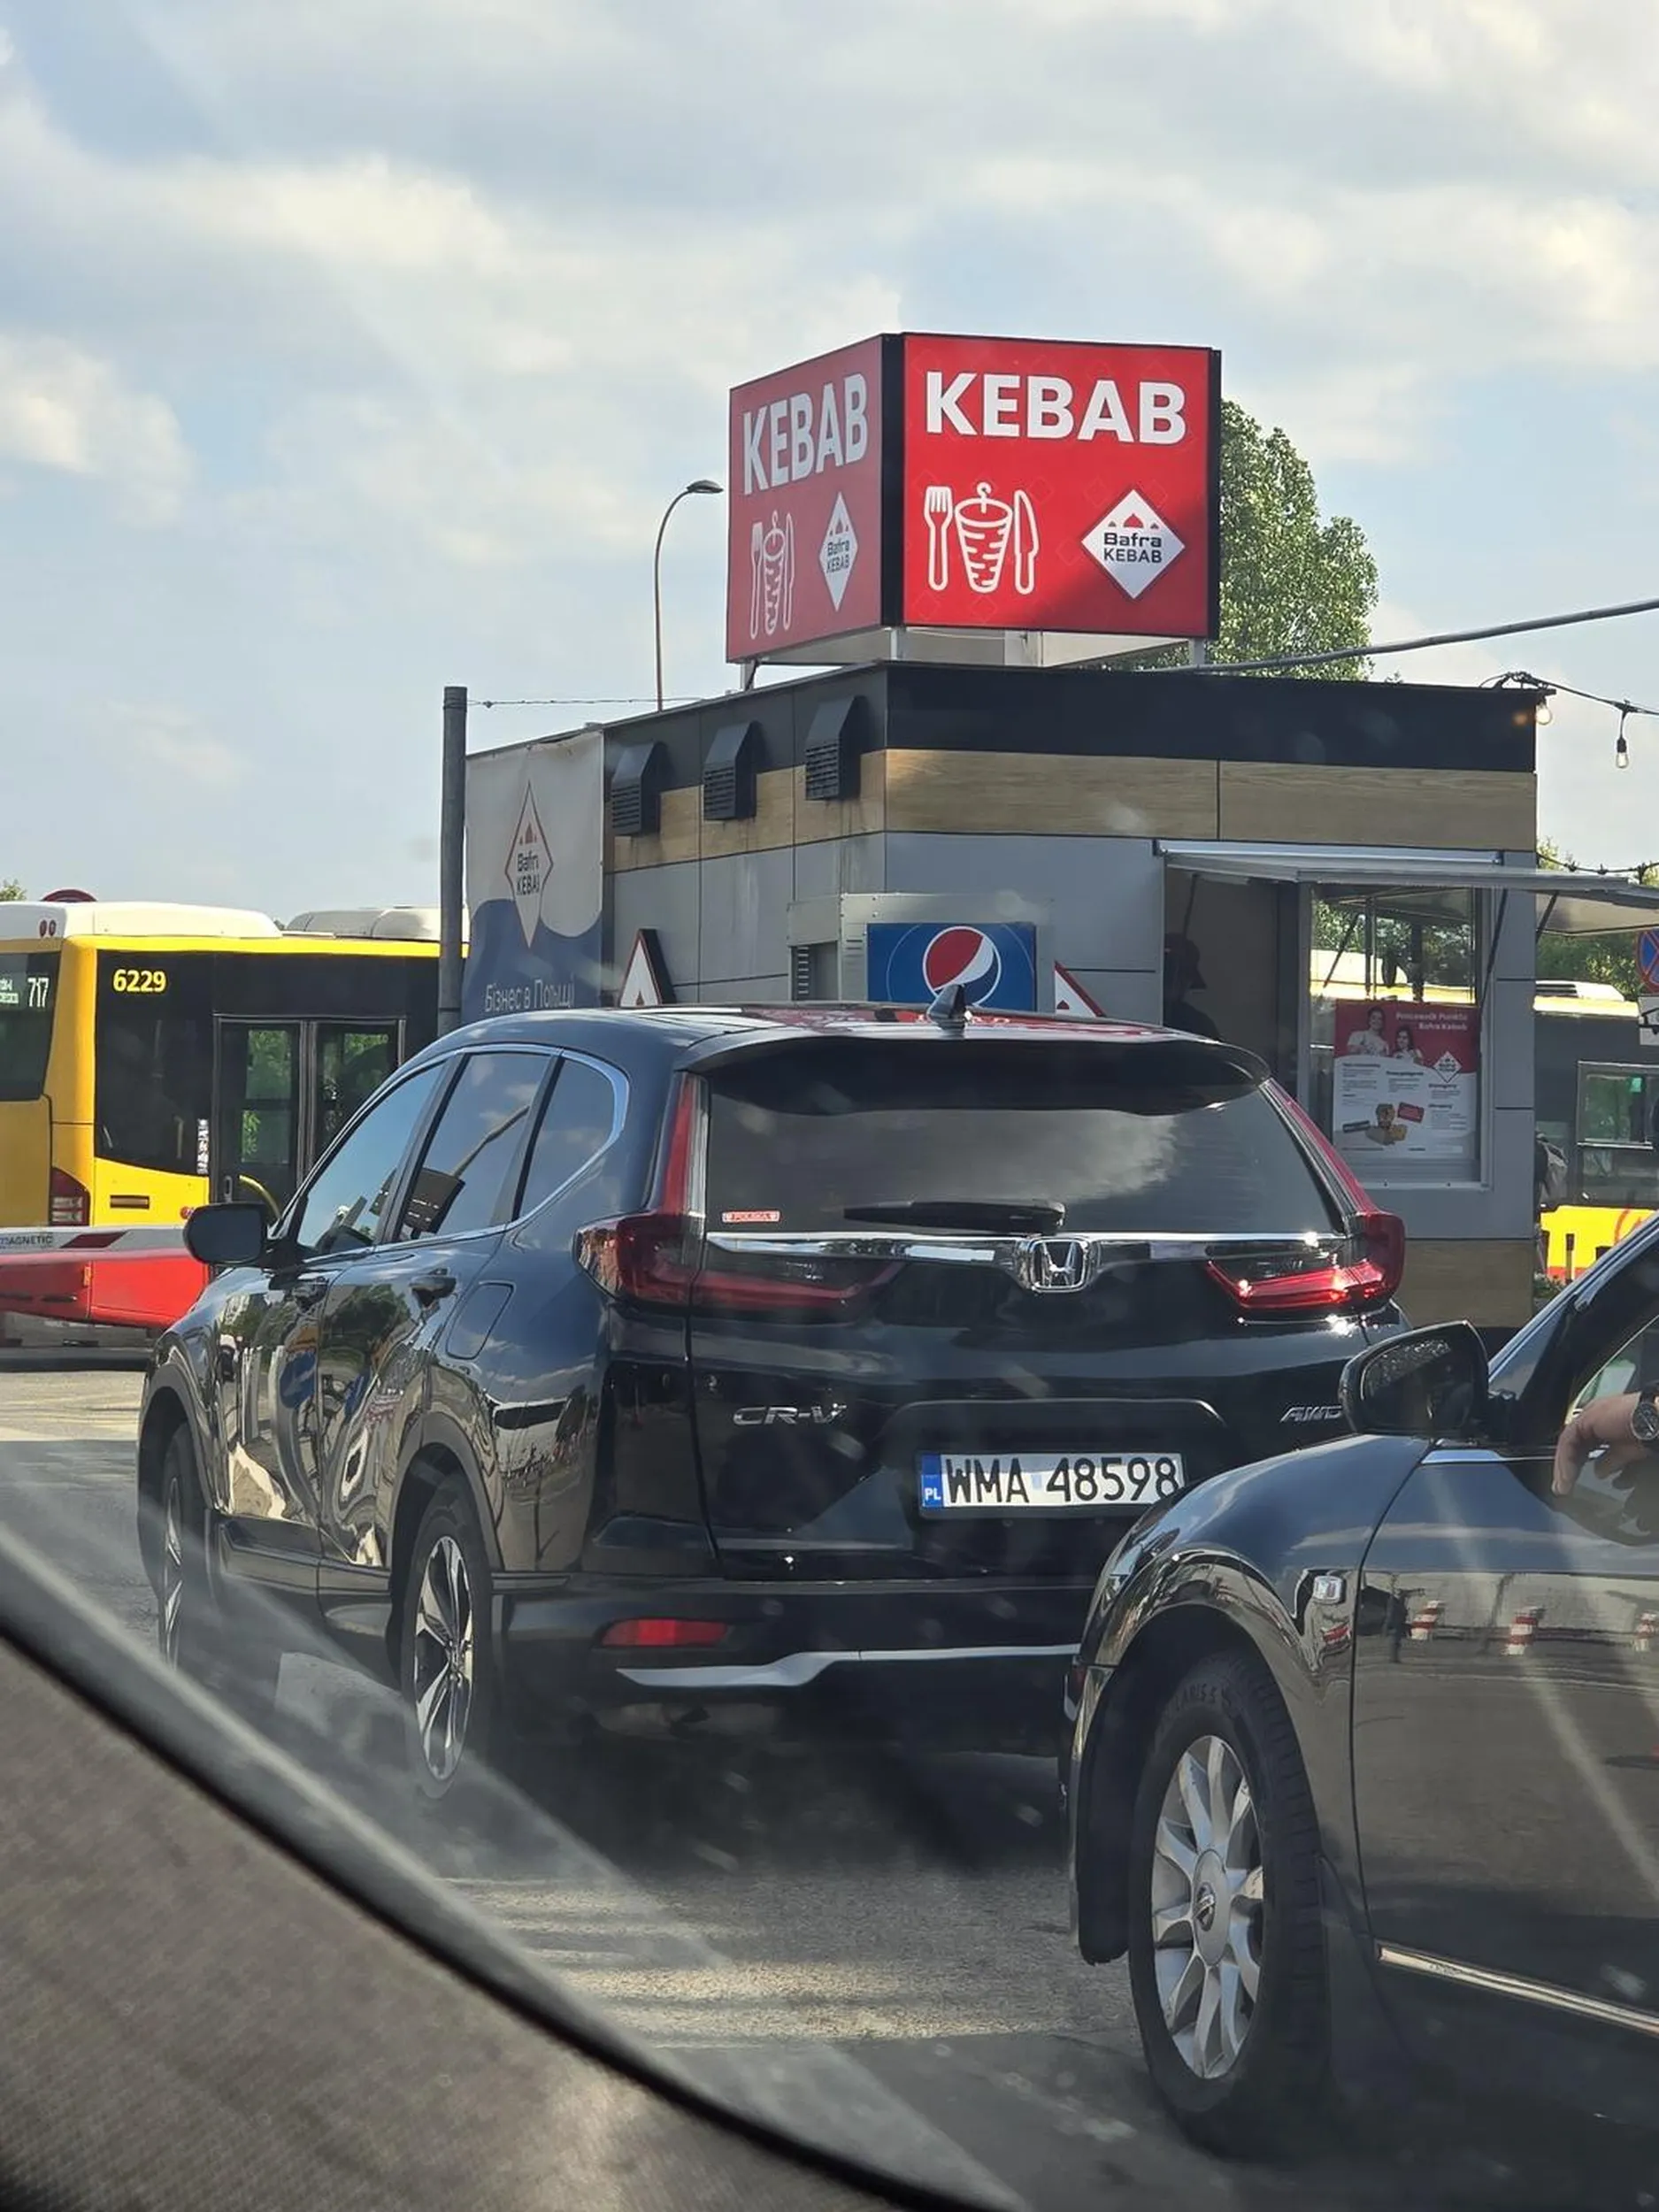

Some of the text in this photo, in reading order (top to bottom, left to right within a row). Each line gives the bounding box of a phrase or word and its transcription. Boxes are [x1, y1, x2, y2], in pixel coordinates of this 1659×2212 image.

[926, 370, 1187, 446] KEBAB
[743, 373, 870, 495] KEBAB
[827, 539, 850, 557] Bafra
[1103, 533, 1162, 548] Bafra
[826, 554, 850, 574] KEBAB
[1103, 548, 1163, 564] KEBAB
[112, 968, 166, 992] 6229
[27, 977, 50, 1007] 717
[733, 1403, 847, 1425] CR-V
[1279, 1405, 1342, 1423] AWD
[946, 1457, 1179, 1503] WMA 48598
[925, 1488, 941, 1502] PL
